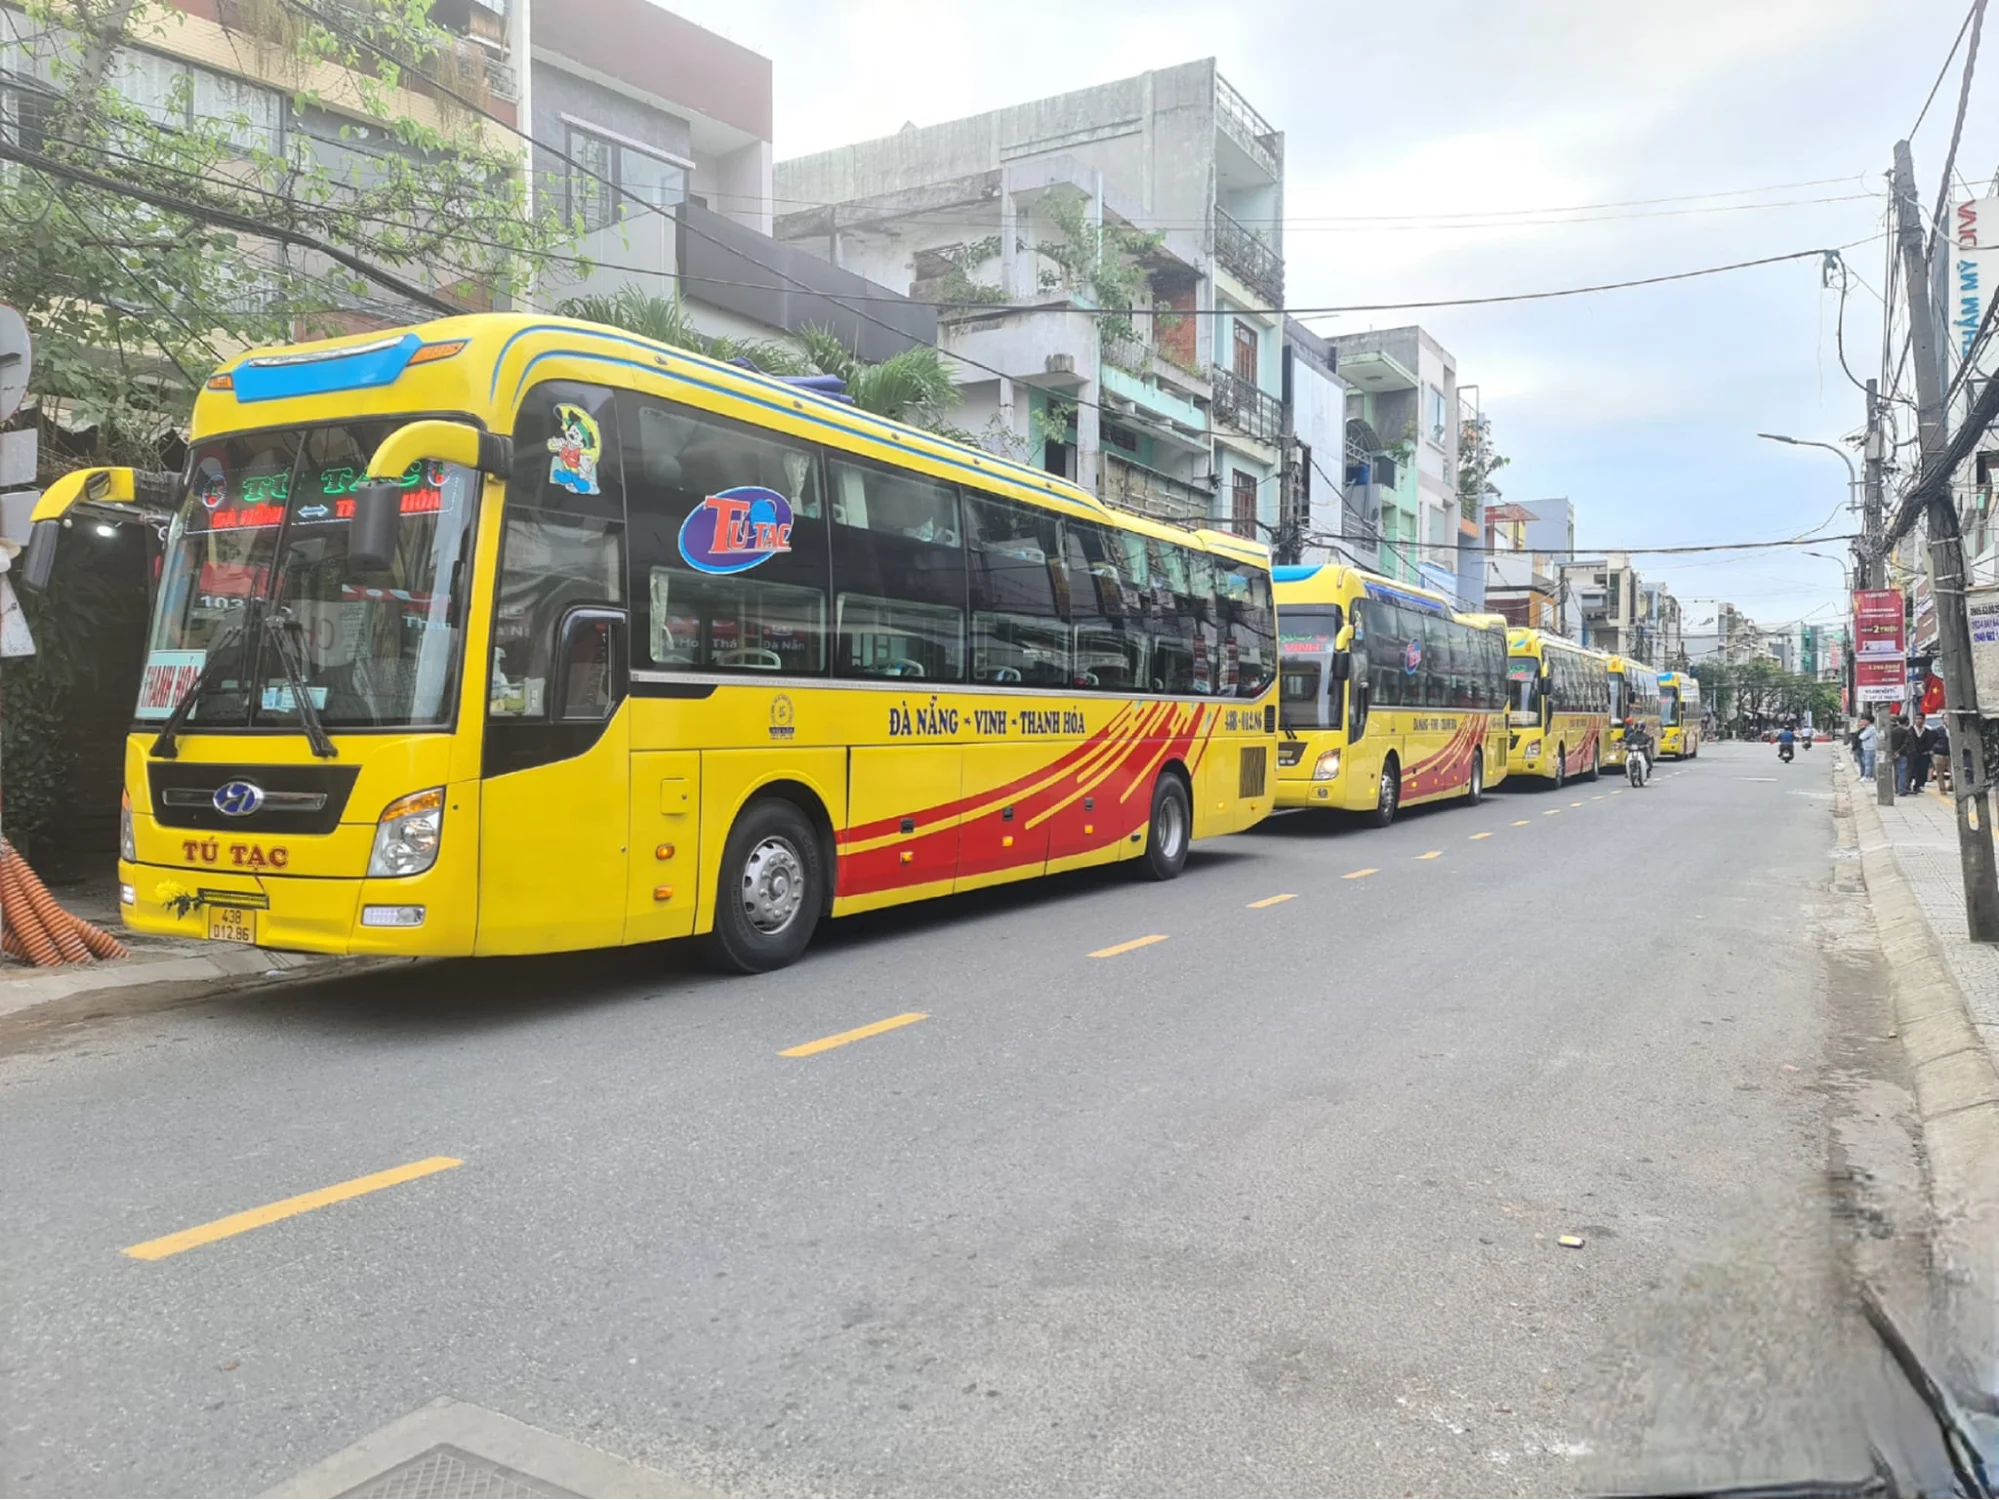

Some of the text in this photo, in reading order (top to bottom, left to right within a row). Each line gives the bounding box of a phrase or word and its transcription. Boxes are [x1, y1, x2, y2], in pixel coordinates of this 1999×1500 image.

[1957, 199, 1977, 250] DIVA
[1956, 260, 1979, 290] MỸ
[889, 695, 1085, 736] ĐÀ NẴNG VINH THANH HÓA
[183, 836, 219, 863] TÚ
[222, 910, 242, 924] 43B
[213, 924, 250, 941] 012.86
